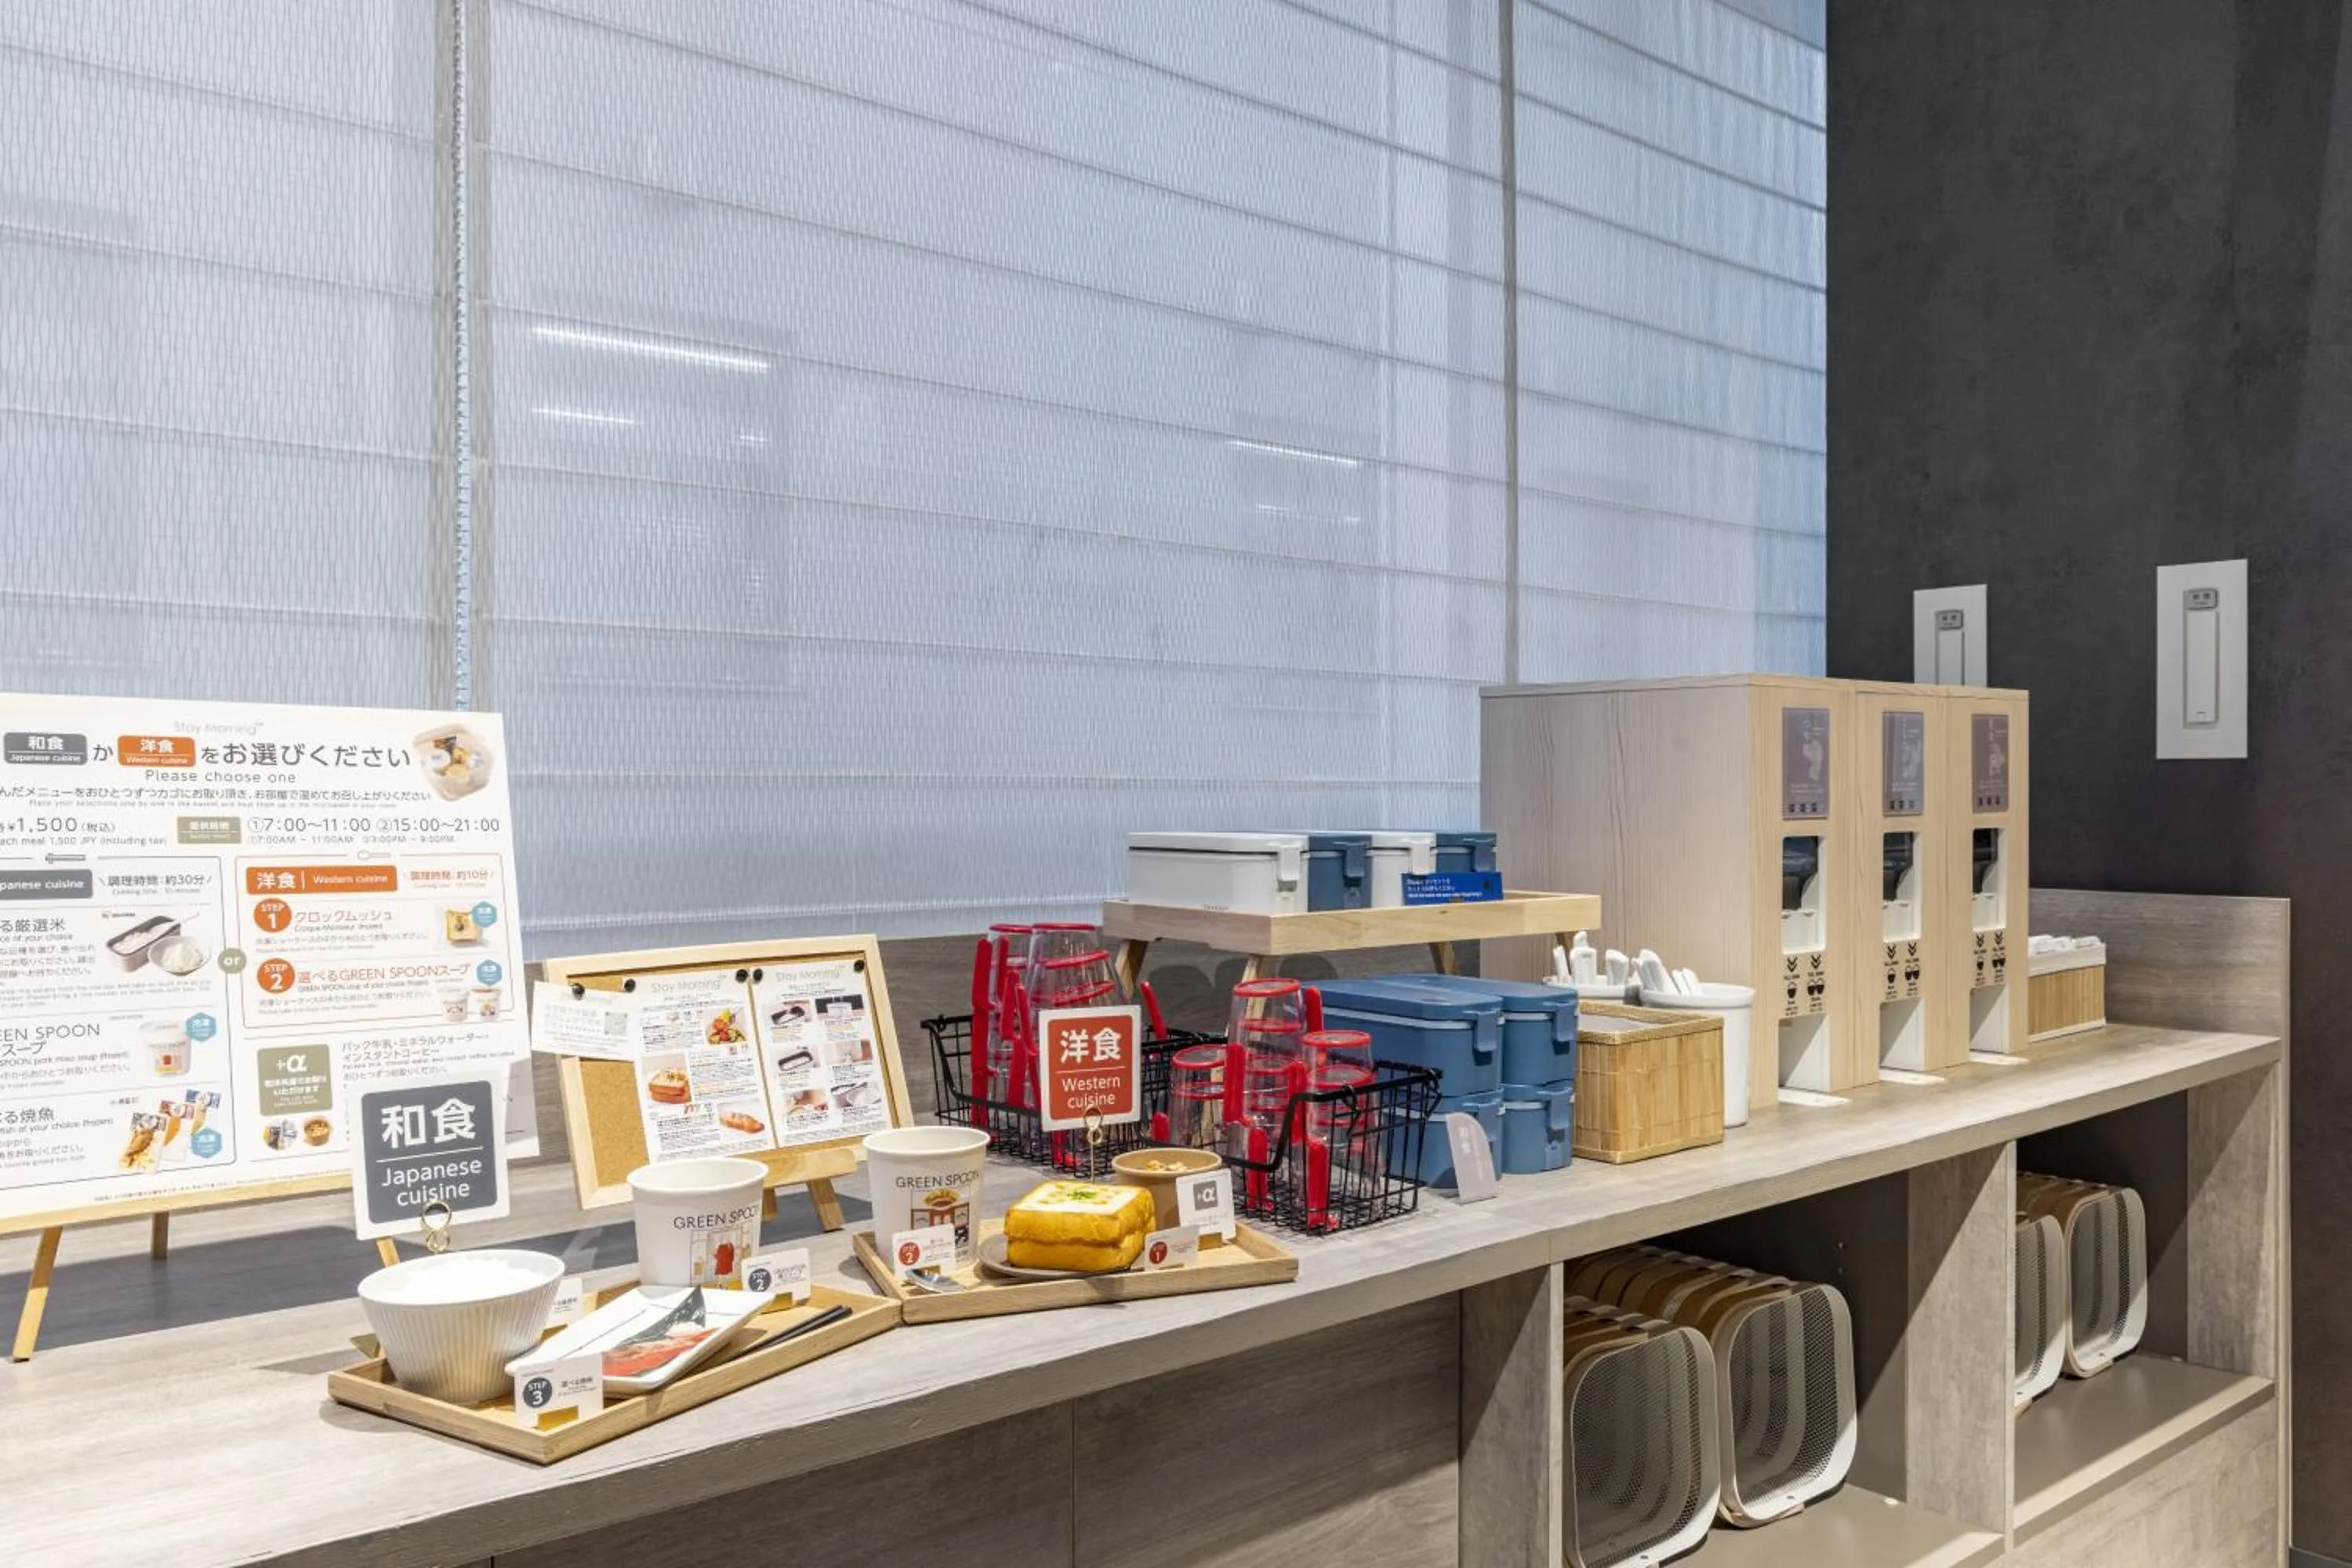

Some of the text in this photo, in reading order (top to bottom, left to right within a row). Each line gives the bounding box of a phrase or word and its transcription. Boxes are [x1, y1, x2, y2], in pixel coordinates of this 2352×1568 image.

[28, 735, 64, 751] 和食
[140, 739, 175, 753] 洋食
[201, 742, 410, 768] をお選びください
[145, 769, 296, 783] Please choose one
[45, 879, 85, 889] cuisine
[256, 871, 389, 890] 洋食 Western cuisine
[261, 902, 285, 913] STEP
[267, 912, 278, 930] 1
[294, 909, 393, 924] クロックムッシュ
[223, 956, 241, 966] or
[264, 964, 288, 973] STEP
[270, 974, 283, 990] 2
[35, 1023, 100, 1041] SPOON
[1060, 1027, 1122, 1064] 洋食
[1062, 1076, 1121, 1093] Western
[1066, 1092, 1117, 1110] cuisine
[380, 1098, 477, 1149] 和食
[380, 1158, 482, 1188] Japanese
[895, 1175, 942, 1189] GREEN
[397, 1181, 471, 1207] cuisine
[673, 1212, 726, 1230] GREEN
[906, 1252, 914, 1264] 2
[756, 1279, 764, 1291] 2
[527, 1380, 549, 1391] STEP
[532, 1390, 543, 1405] 3
